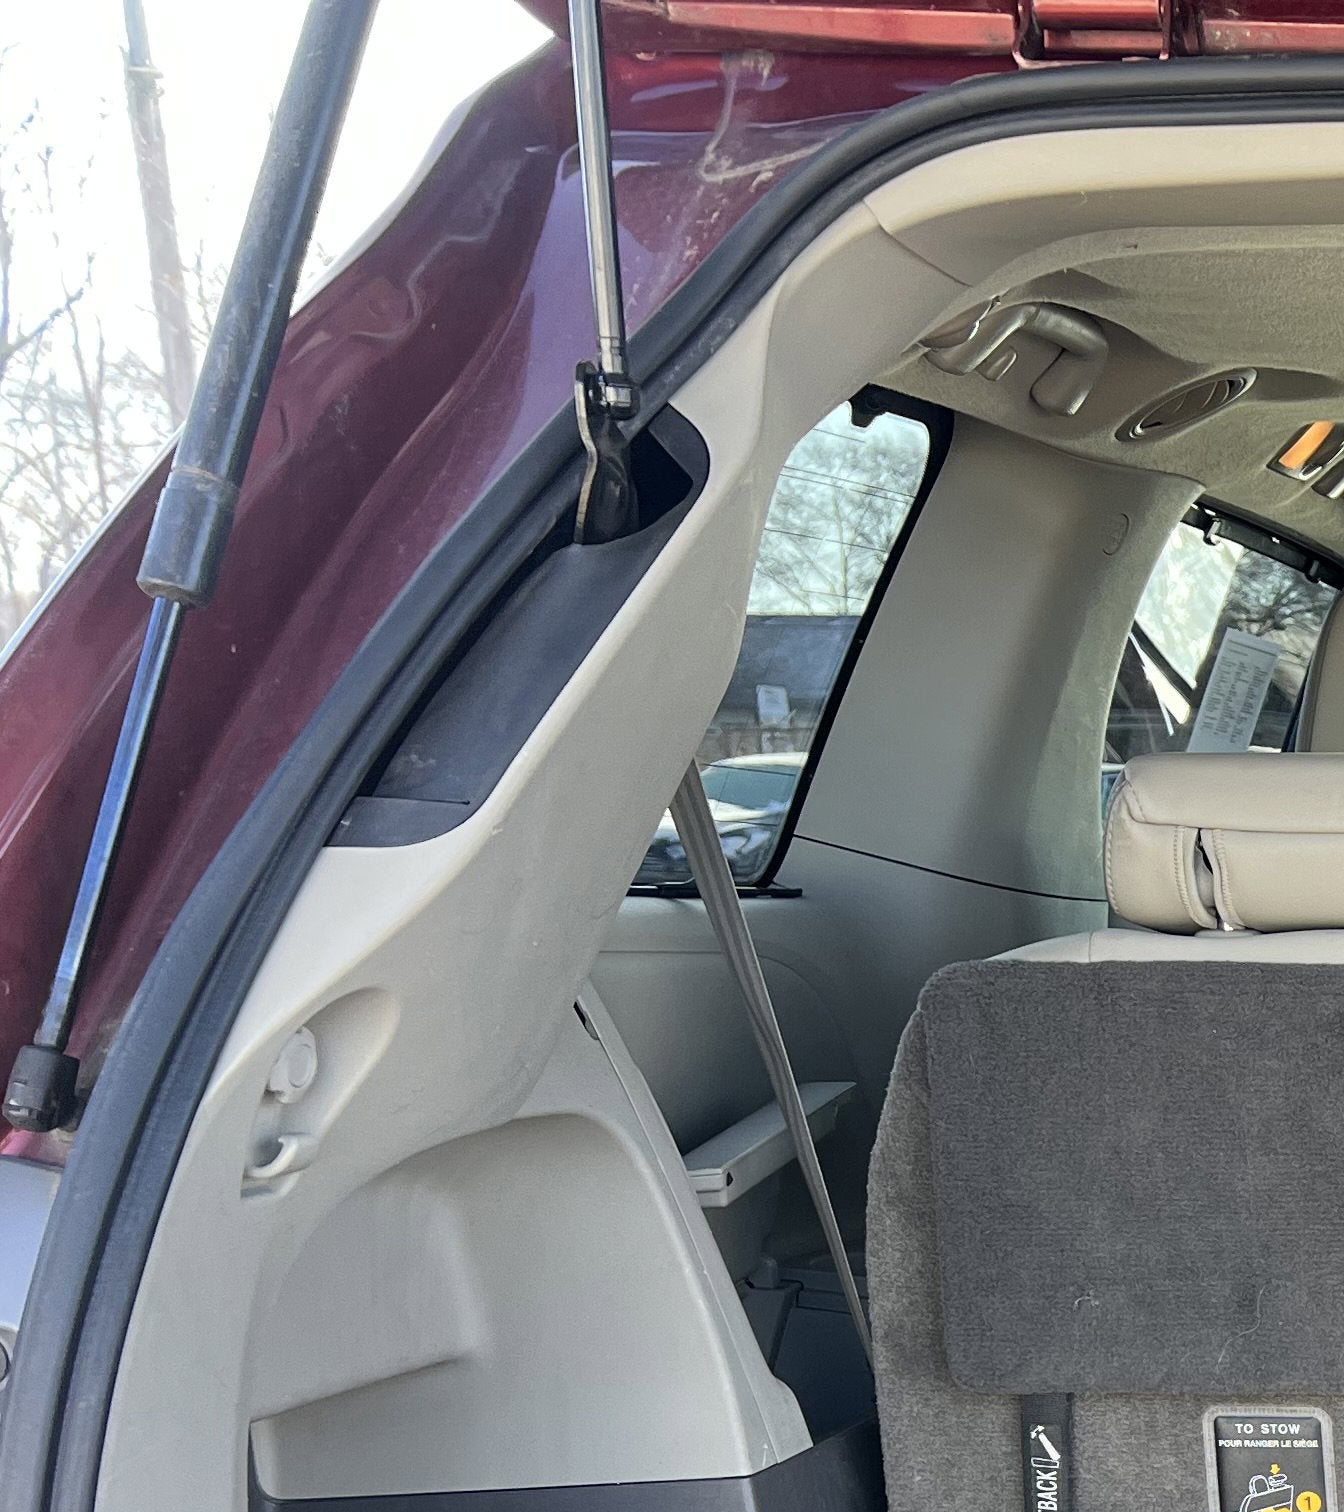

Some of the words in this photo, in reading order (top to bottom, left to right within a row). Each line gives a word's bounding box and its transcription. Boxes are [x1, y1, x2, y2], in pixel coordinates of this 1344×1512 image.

[1235, 1424, 1254, 1434] TO
[1261, 1424, 1301, 1434] STOW
[1219, 1440, 1242, 1448] POUR
[1244, 1440, 1280, 1448] RANGER
[1281, 1440, 1292, 1448] LE
